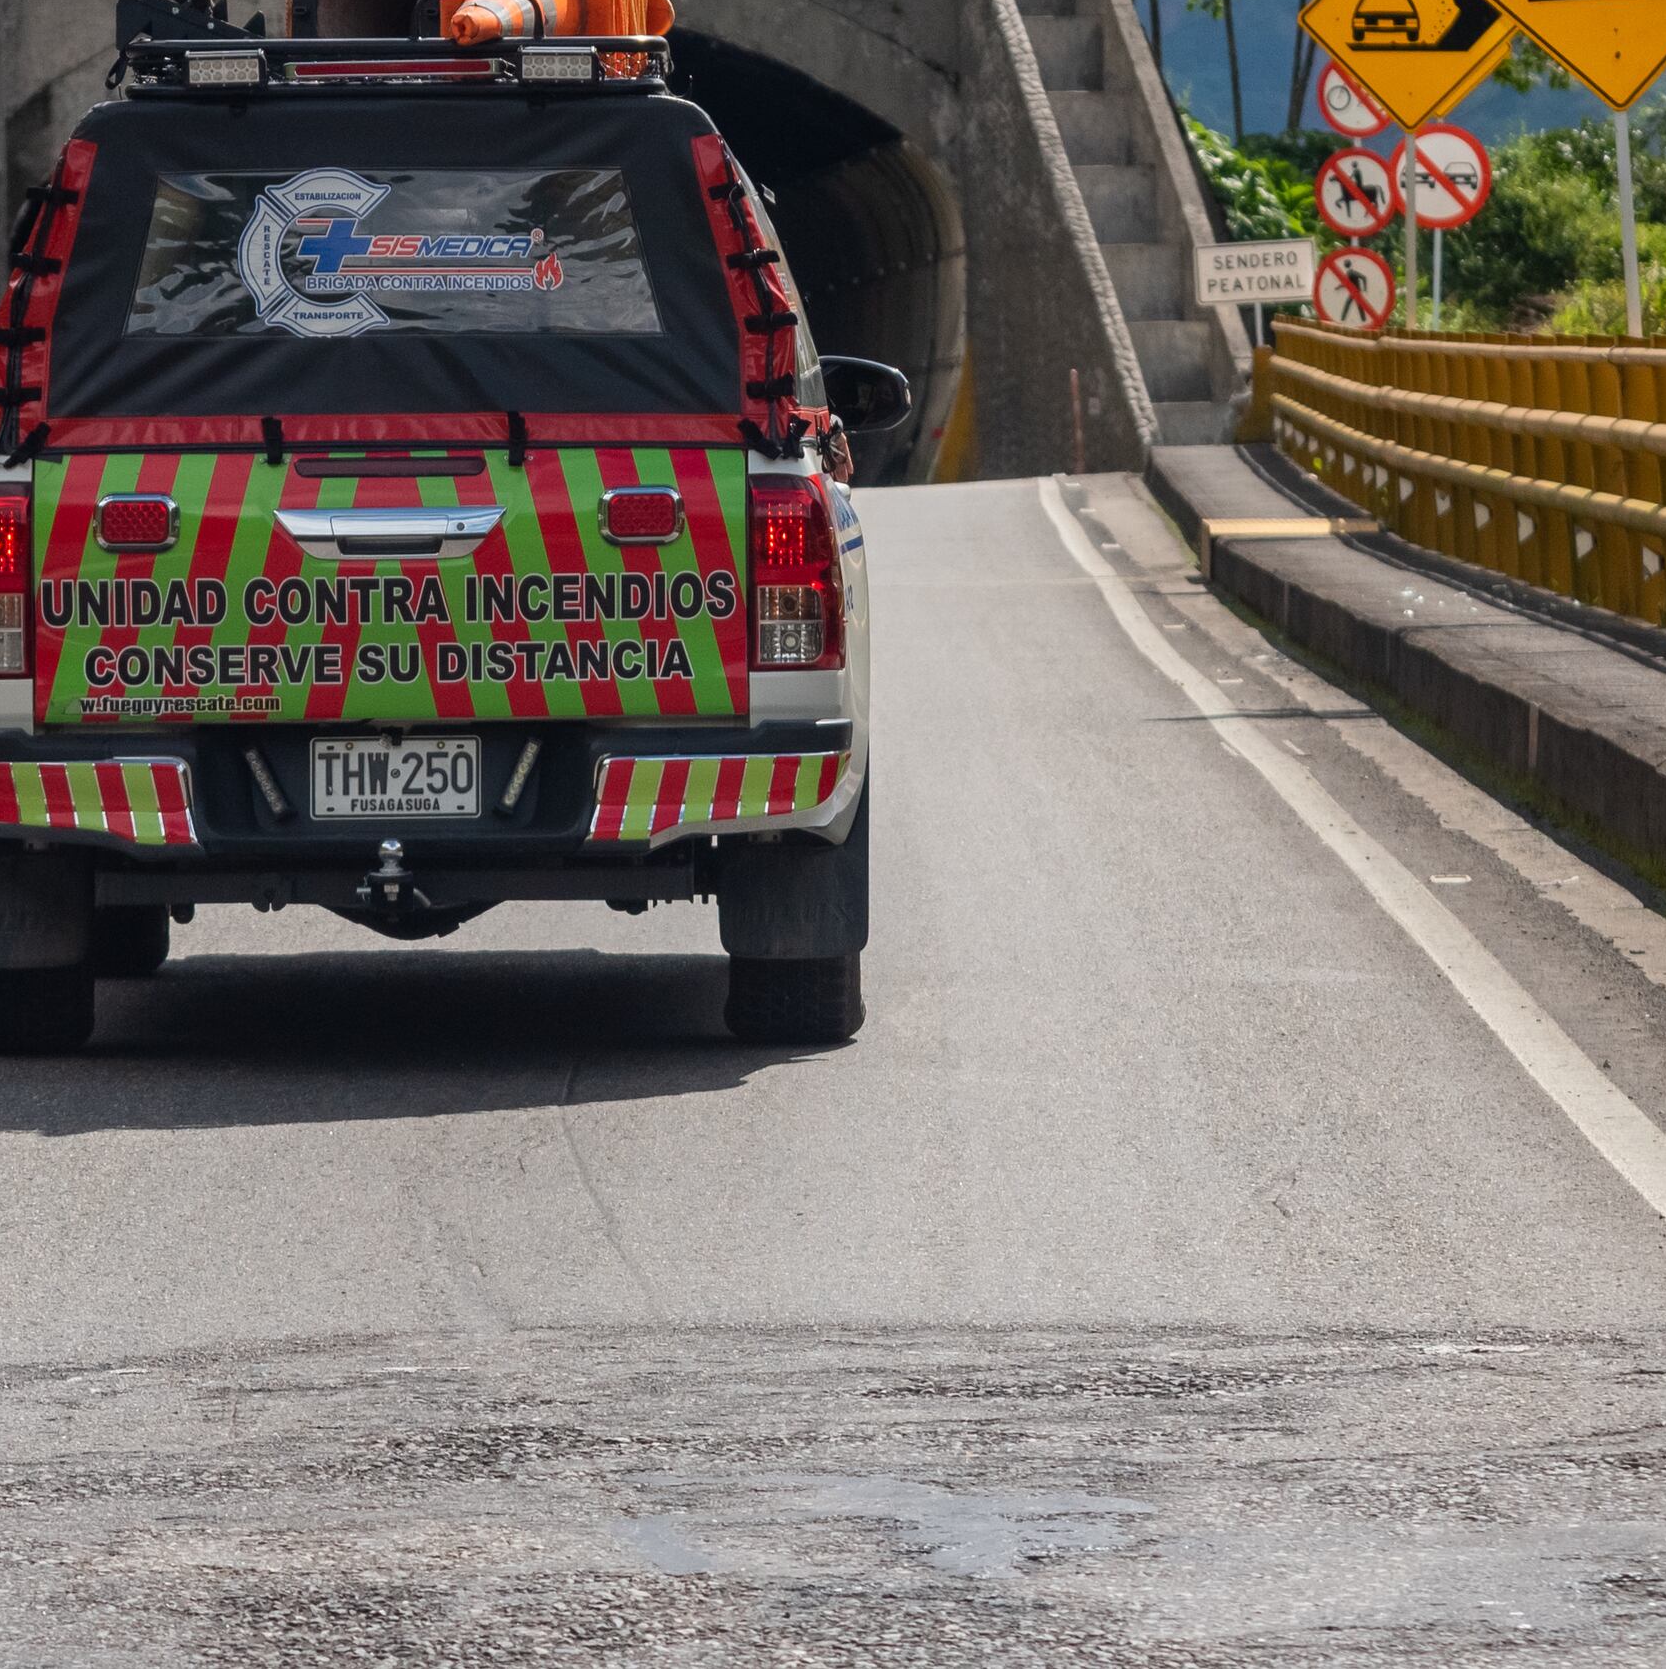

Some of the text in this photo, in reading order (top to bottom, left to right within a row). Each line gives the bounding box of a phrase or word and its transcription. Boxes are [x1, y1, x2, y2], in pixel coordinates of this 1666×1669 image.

[294, 192, 361, 201] ESTABILIZACION
[263, 225, 271, 286] RESCATE
[1214, 250, 1298, 270] SENDERO
[306, 274, 533, 291] BRIGADA CONTRA INCENDIOS
[1207, 273, 1306, 294] PEATONAL
[293, 311, 364, 320] TRANSPORTE
[41, 570, 736, 629] UNIDAD CONTRA INCENDIOS
[84, 639, 694, 687] CONSERVE SU DISTANCIA
[350, 798, 441, 813] FUSAGASUGA
